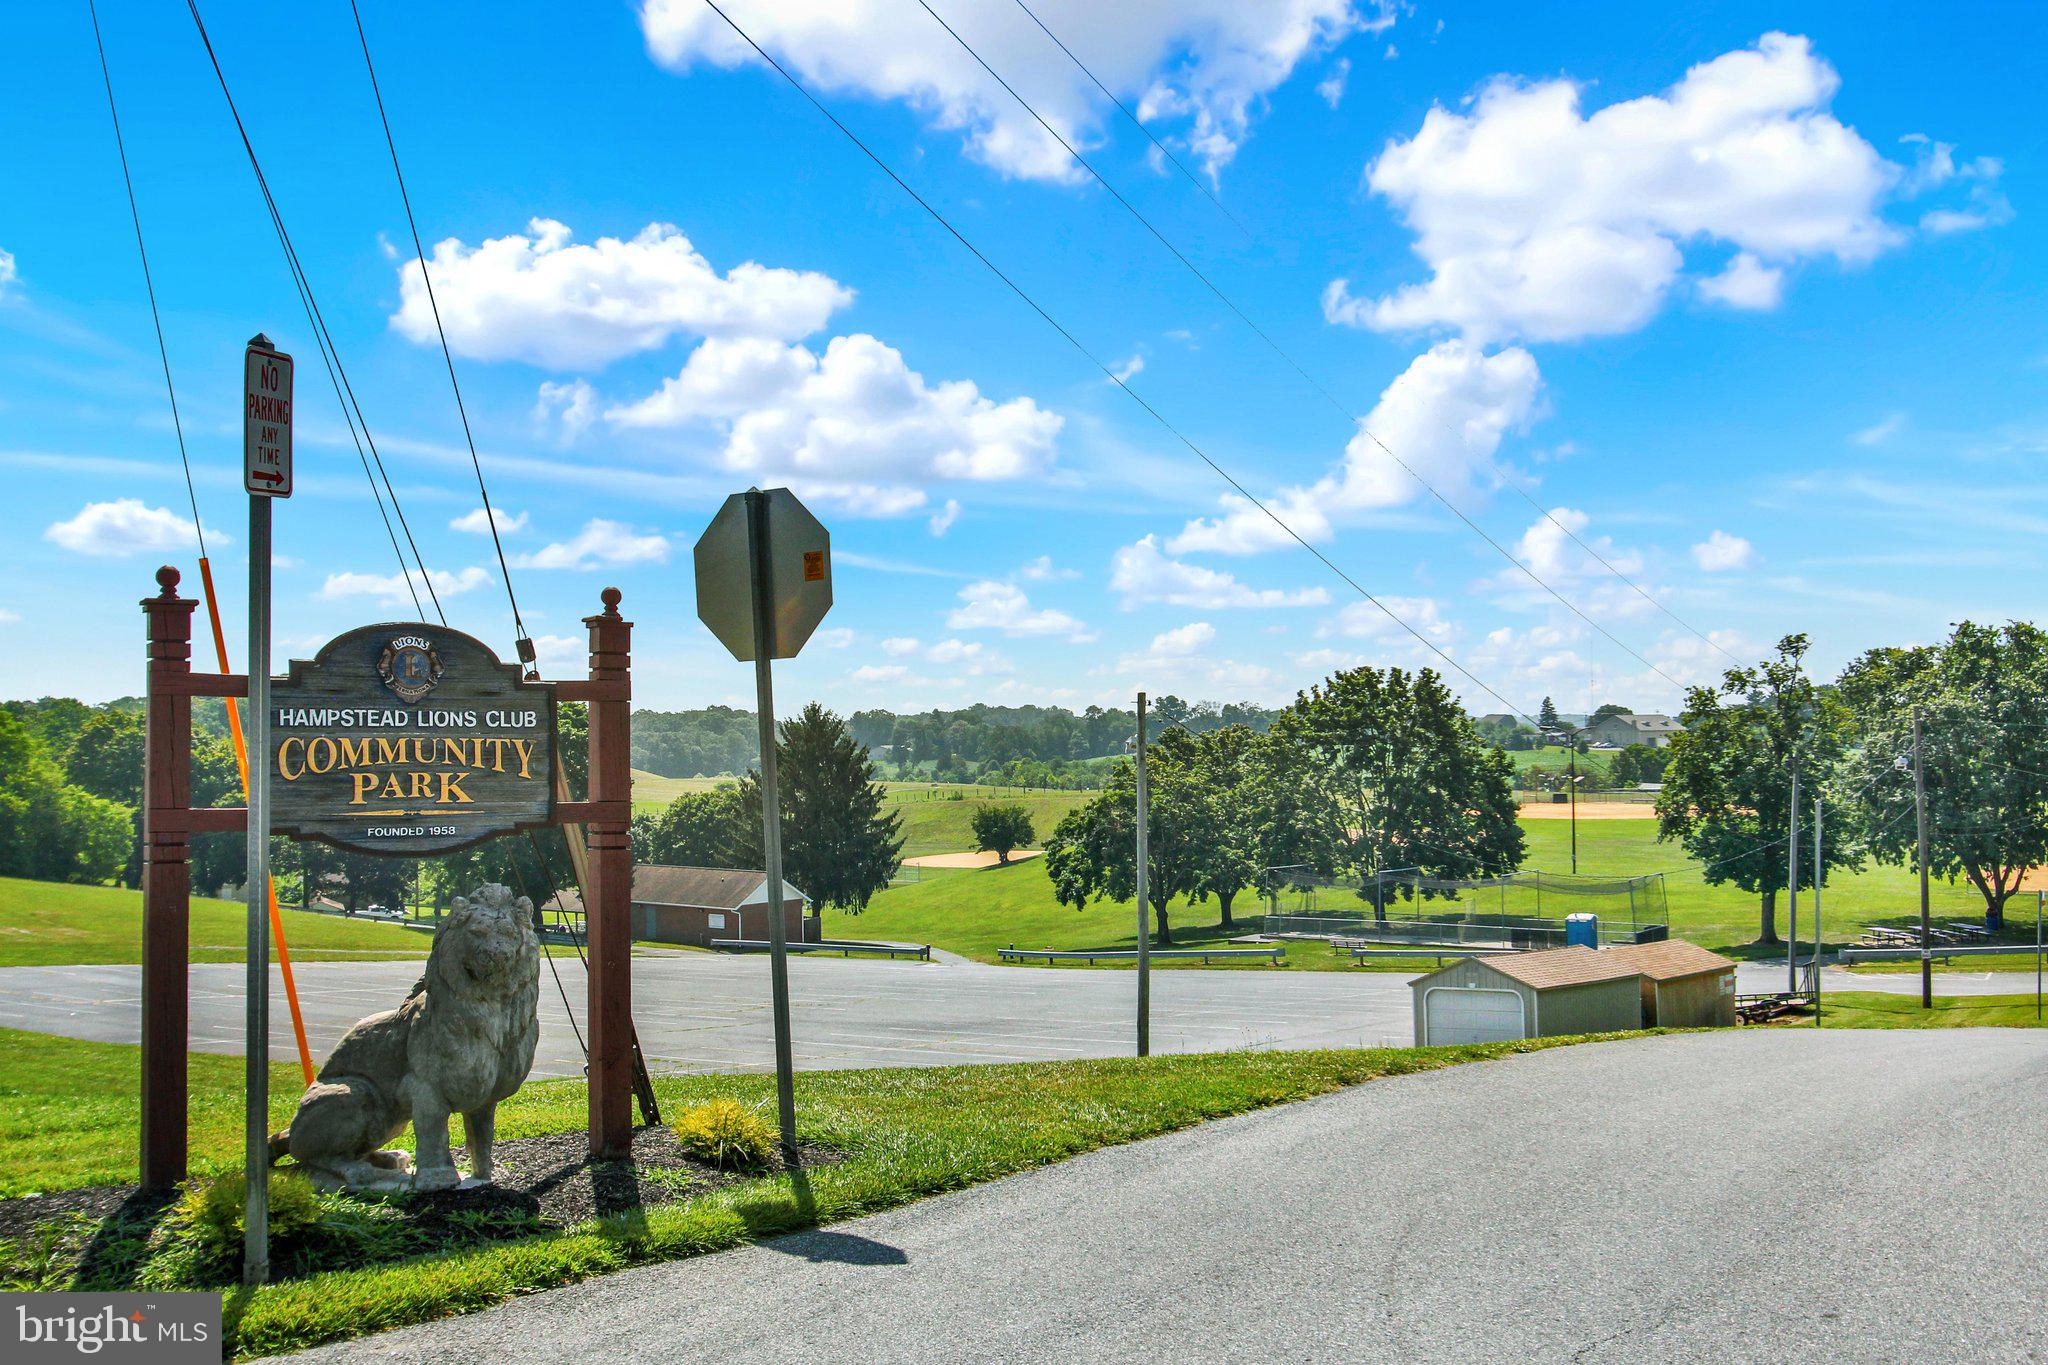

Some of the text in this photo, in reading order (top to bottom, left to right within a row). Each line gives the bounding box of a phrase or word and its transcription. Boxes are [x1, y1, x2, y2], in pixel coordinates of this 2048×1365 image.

[261, 364, 278, 391] NO
[249, 393, 289, 425] PARKING
[261, 427, 278, 444] ANY
[258, 446, 280, 466] TIME
[392, 636, 430, 650] LIONS
[279, 708, 537, 728] HAMPSTEAD LIONS CLUB
[278, 736, 537, 781] COMMUNITY
[349, 772, 475, 805] PARK
[367, 826, 424, 837] FOUNDED
